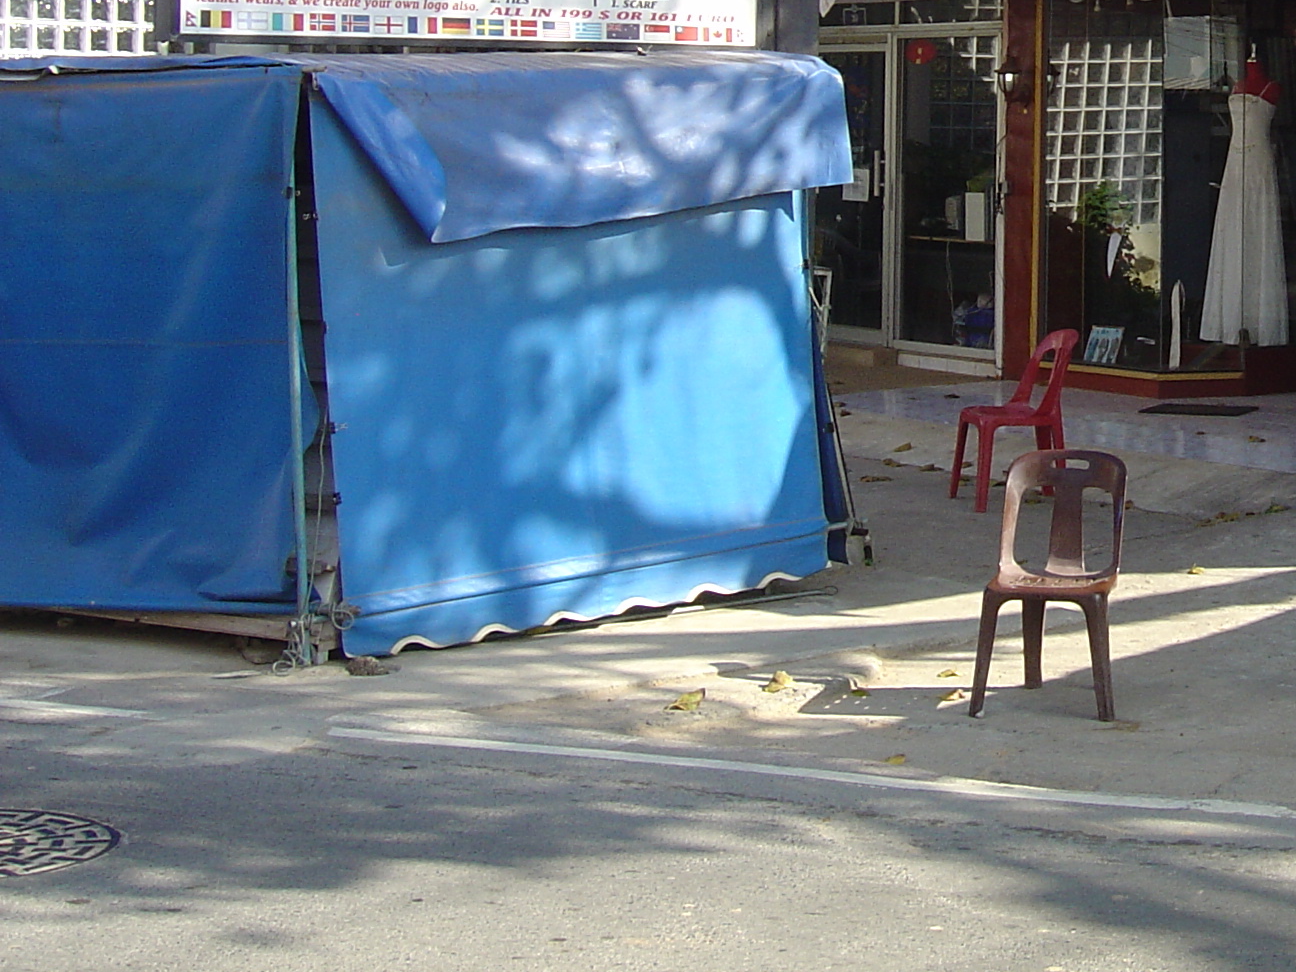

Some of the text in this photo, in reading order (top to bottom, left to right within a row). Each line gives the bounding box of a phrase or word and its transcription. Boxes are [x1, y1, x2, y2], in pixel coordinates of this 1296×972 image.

[364, 0, 392, 10] your
[394, 0, 420, 9] own
[423, 0, 448, 13] logo
[622, 0, 657, 9] SCARF
[490, 7, 524, 16] ALL
[530, 8, 551, 17] IN
[560, 9, 592, 18] 199
[616, 11, 642, 20] OR
[650, 12, 677, 21] 161
